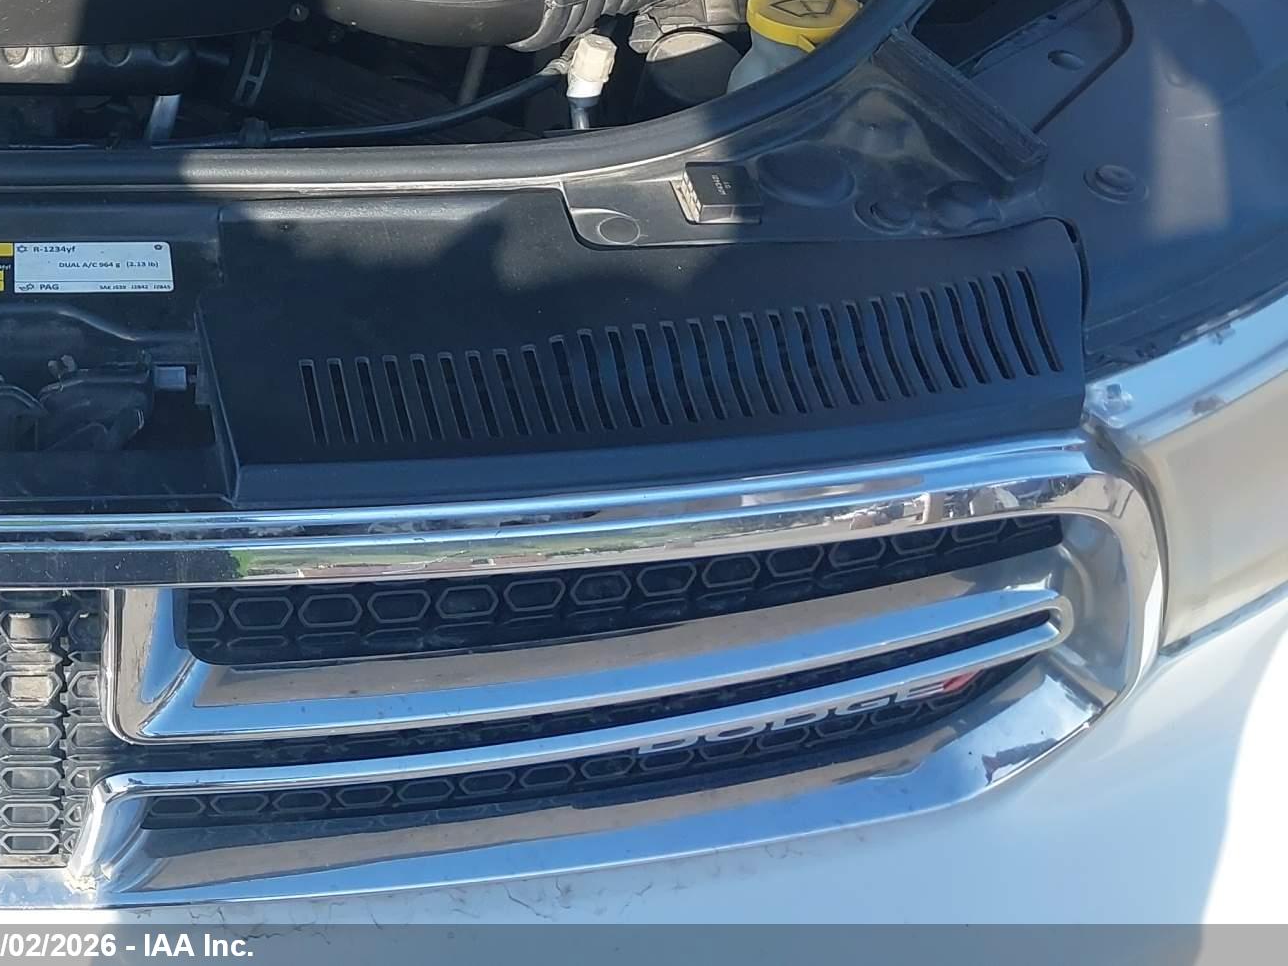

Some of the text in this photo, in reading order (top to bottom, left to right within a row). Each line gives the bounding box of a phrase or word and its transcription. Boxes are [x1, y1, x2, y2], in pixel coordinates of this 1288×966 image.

[33, 245, 76, 254] R-1234yf
[58, 261, 81, 269] DUAL
[82, 261, 98, 269] A/C
[99, 261, 114, 269] 964
[148, 260, 159, 269] lb)
[39, 283, 60, 291] PAG
[638, 682, 946, 755] DODGE
